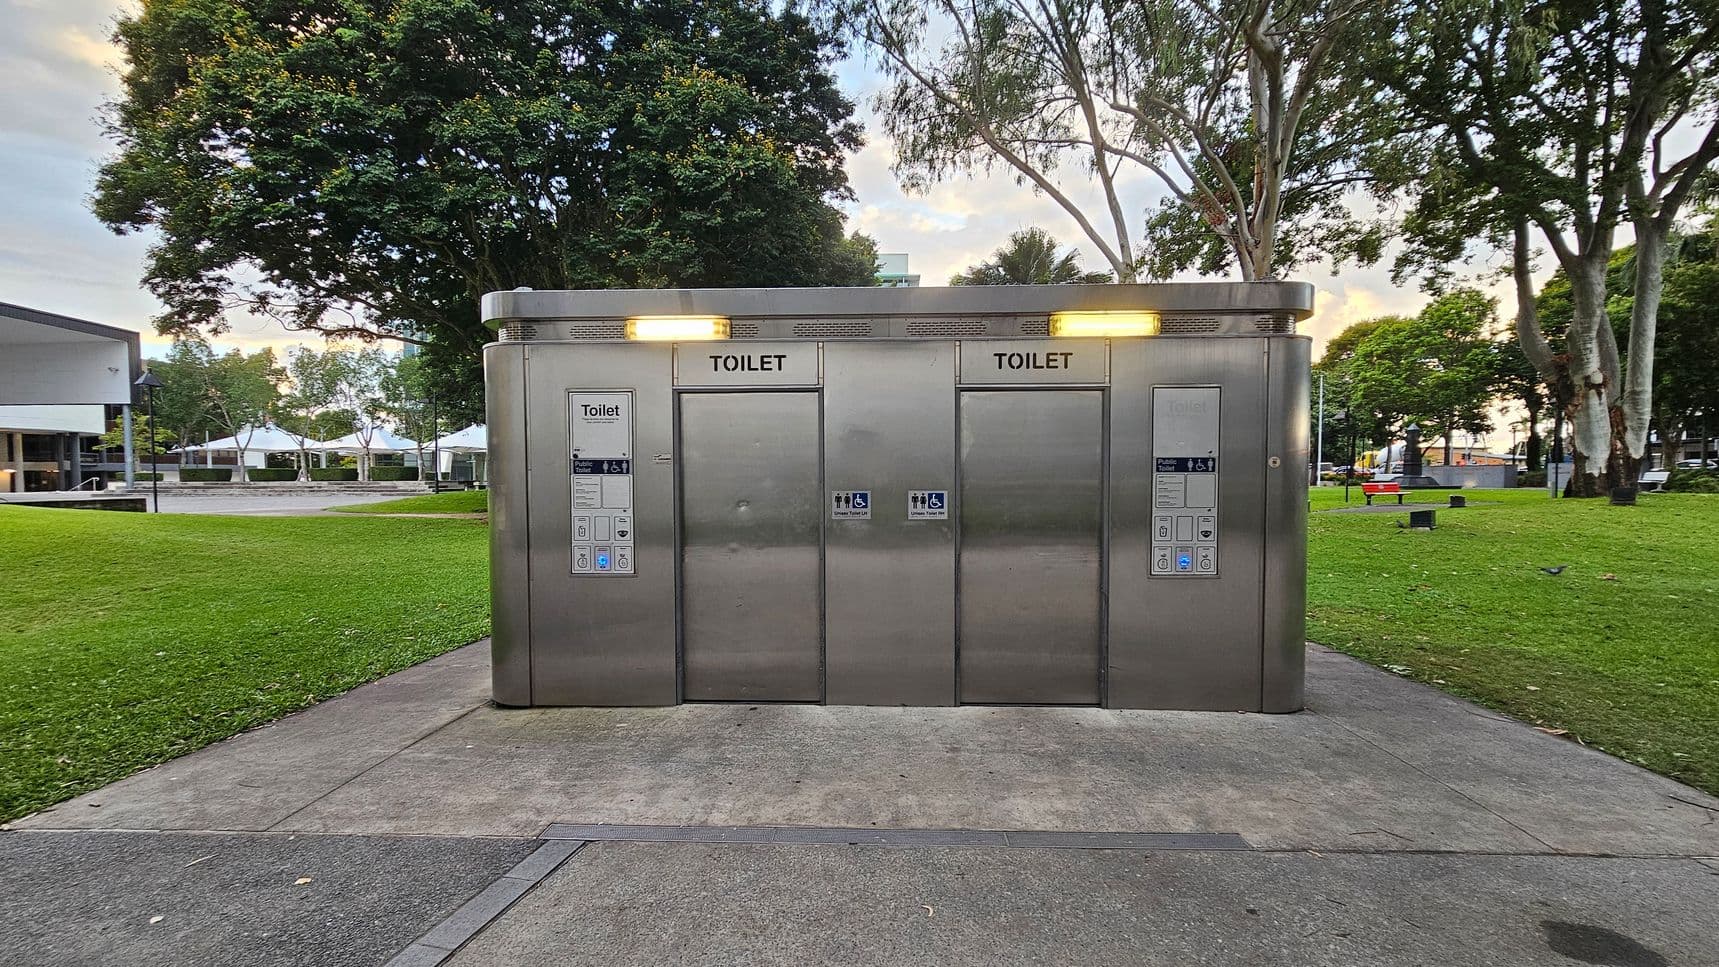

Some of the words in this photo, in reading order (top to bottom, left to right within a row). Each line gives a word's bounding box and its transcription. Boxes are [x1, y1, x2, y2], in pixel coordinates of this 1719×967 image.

[709, 354, 787, 371] TOILET
[993, 352, 1073, 370] TOILET
[581, 404, 620, 416] Toilet
